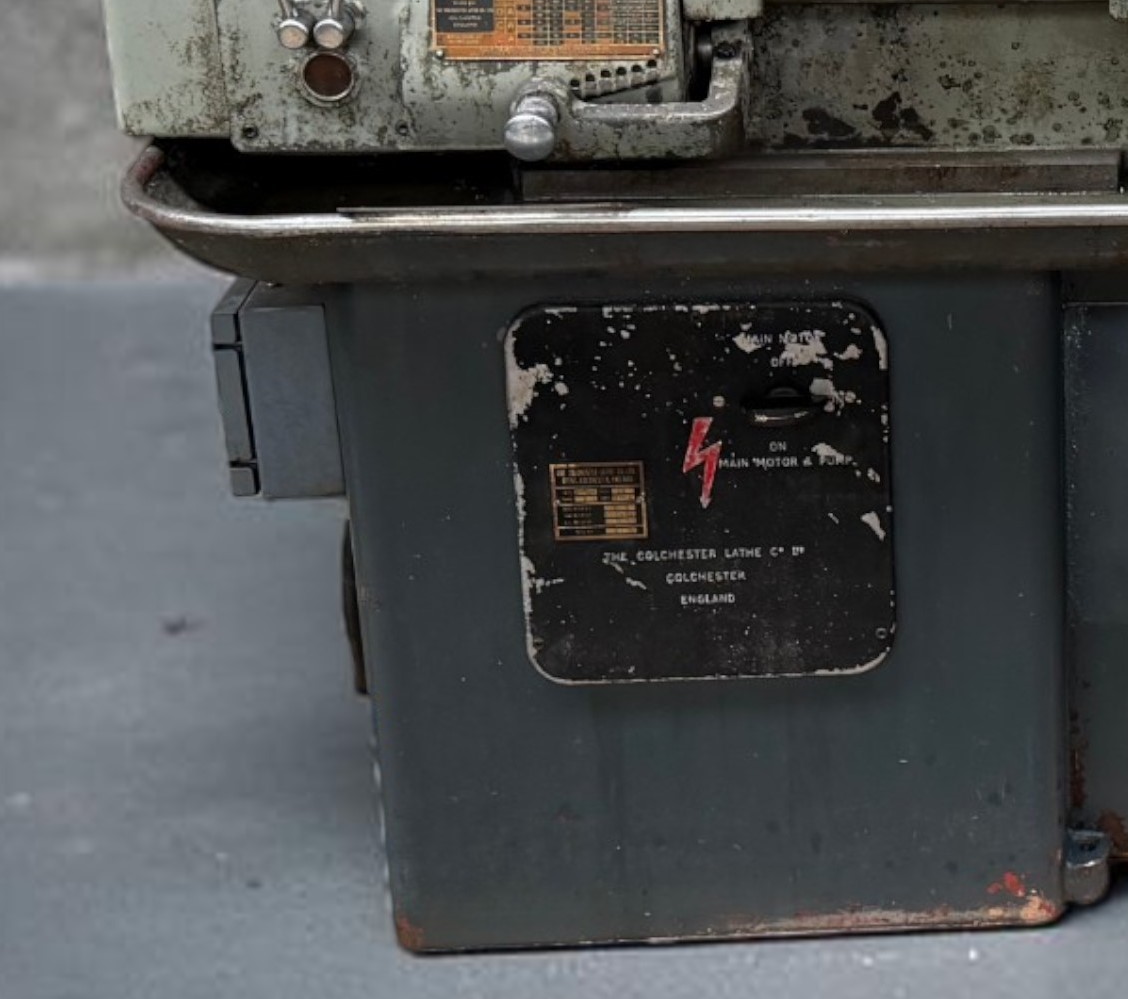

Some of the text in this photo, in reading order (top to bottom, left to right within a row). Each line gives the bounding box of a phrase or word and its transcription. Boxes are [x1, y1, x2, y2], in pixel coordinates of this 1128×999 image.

[769, 441, 787, 452] ON
[719, 457, 749, 469] MAIN
[603, 552, 628, 563] THE
[636, 549, 717, 562] COLCHESTER
[724, 547, 762, 558] LATHE
[666, 570, 746, 584] COLCHESTER
[680, 593, 736, 605] ENGLAND
